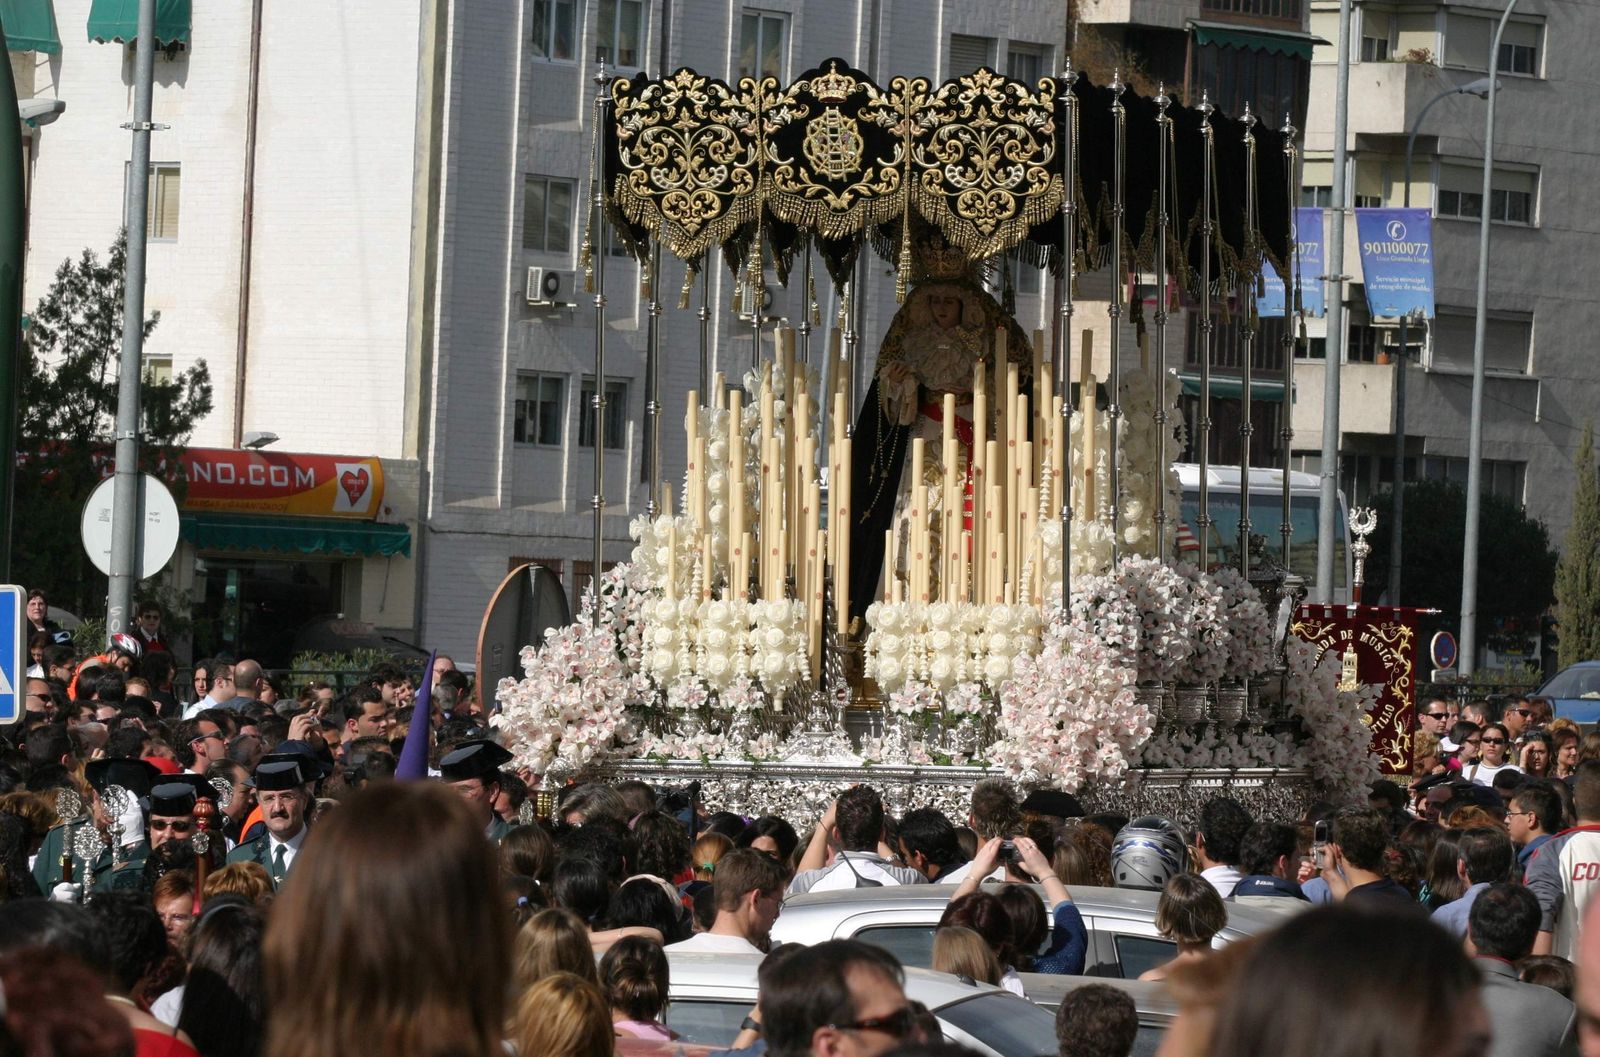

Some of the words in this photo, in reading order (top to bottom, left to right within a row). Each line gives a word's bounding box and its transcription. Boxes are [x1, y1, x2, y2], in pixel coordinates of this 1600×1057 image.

[1363, 242, 1429, 256] 901100077
[171, 460, 315, 488] NO.COM
[1340, 629, 1354, 640] DE
[1359, 631, 1394, 669] MUSICA
[1370, 704, 1395, 734] TILLO
[1572, 862, 1600, 881] CO
